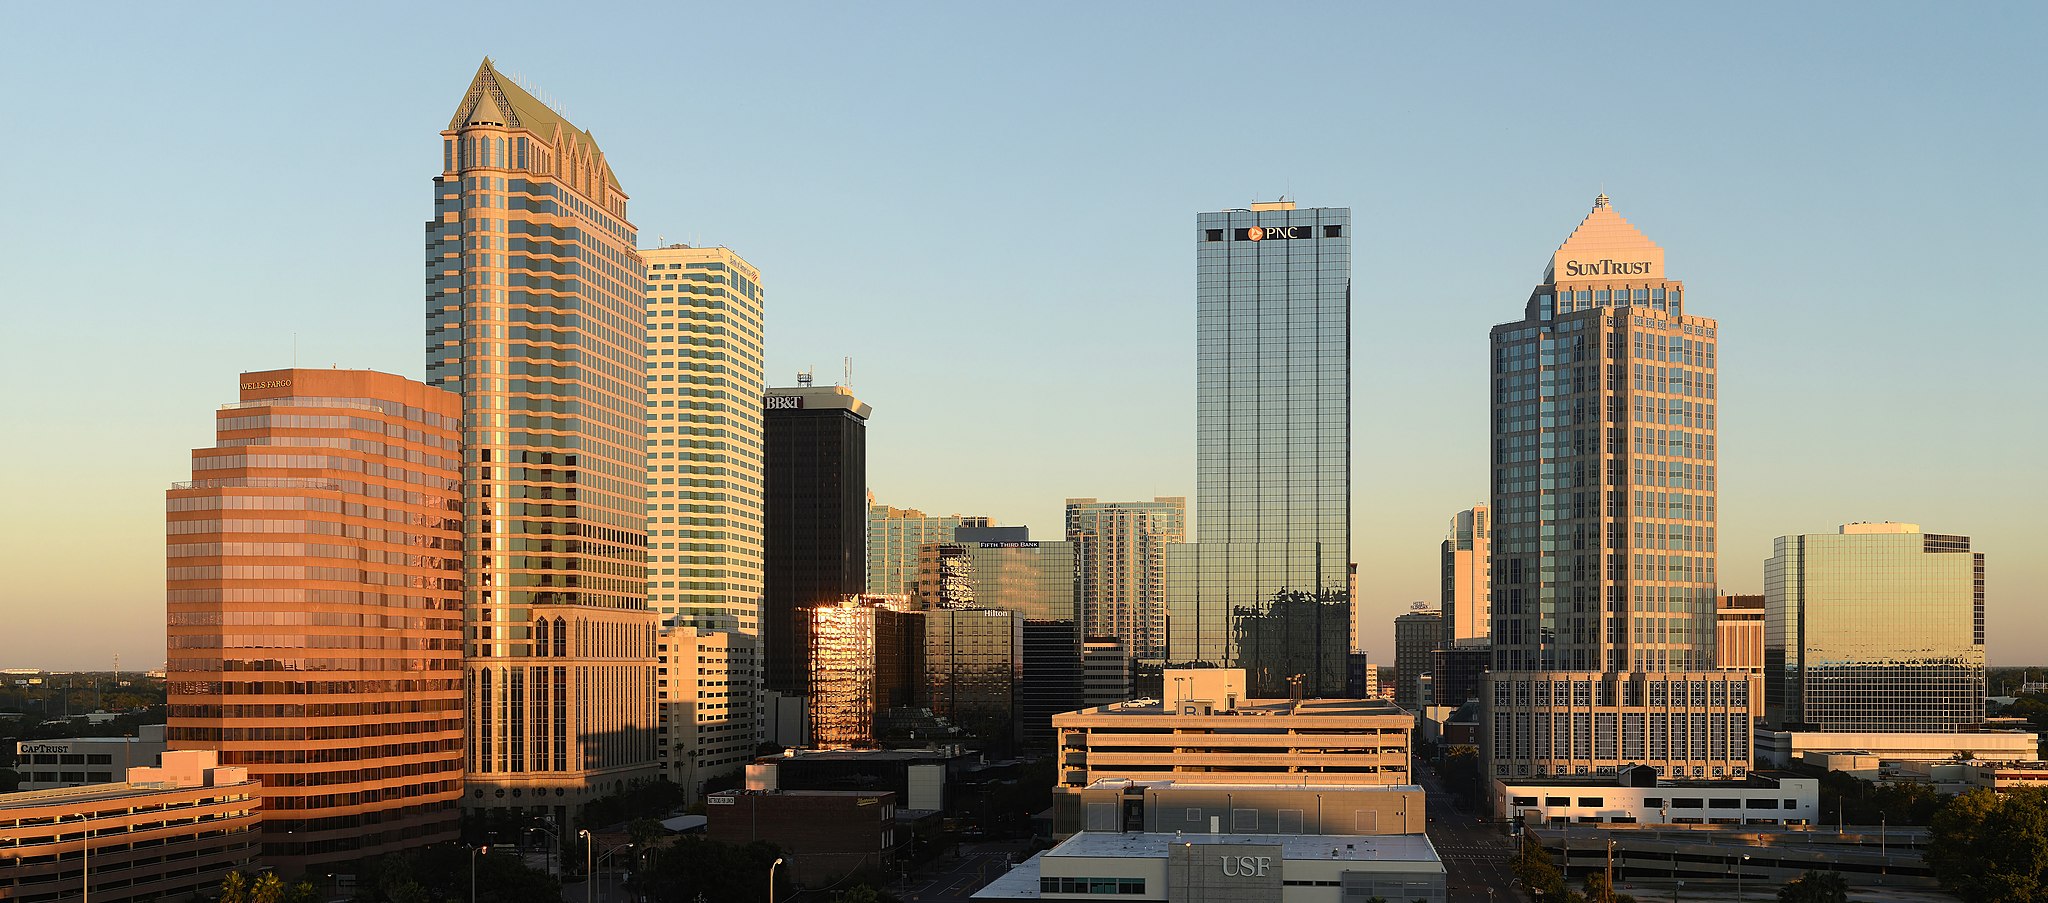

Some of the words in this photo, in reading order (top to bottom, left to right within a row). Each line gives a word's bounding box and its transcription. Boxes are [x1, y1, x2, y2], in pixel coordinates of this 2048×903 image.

[1265, 226, 1298, 239] PNC
[240, 381, 266, 390] WELLS
[267, 379, 292, 388] FARGO
[765, 396, 801, 409] BB&T
[984, 609, 1008, 617] Hilton
[1220, 855, 1271, 877] USF
